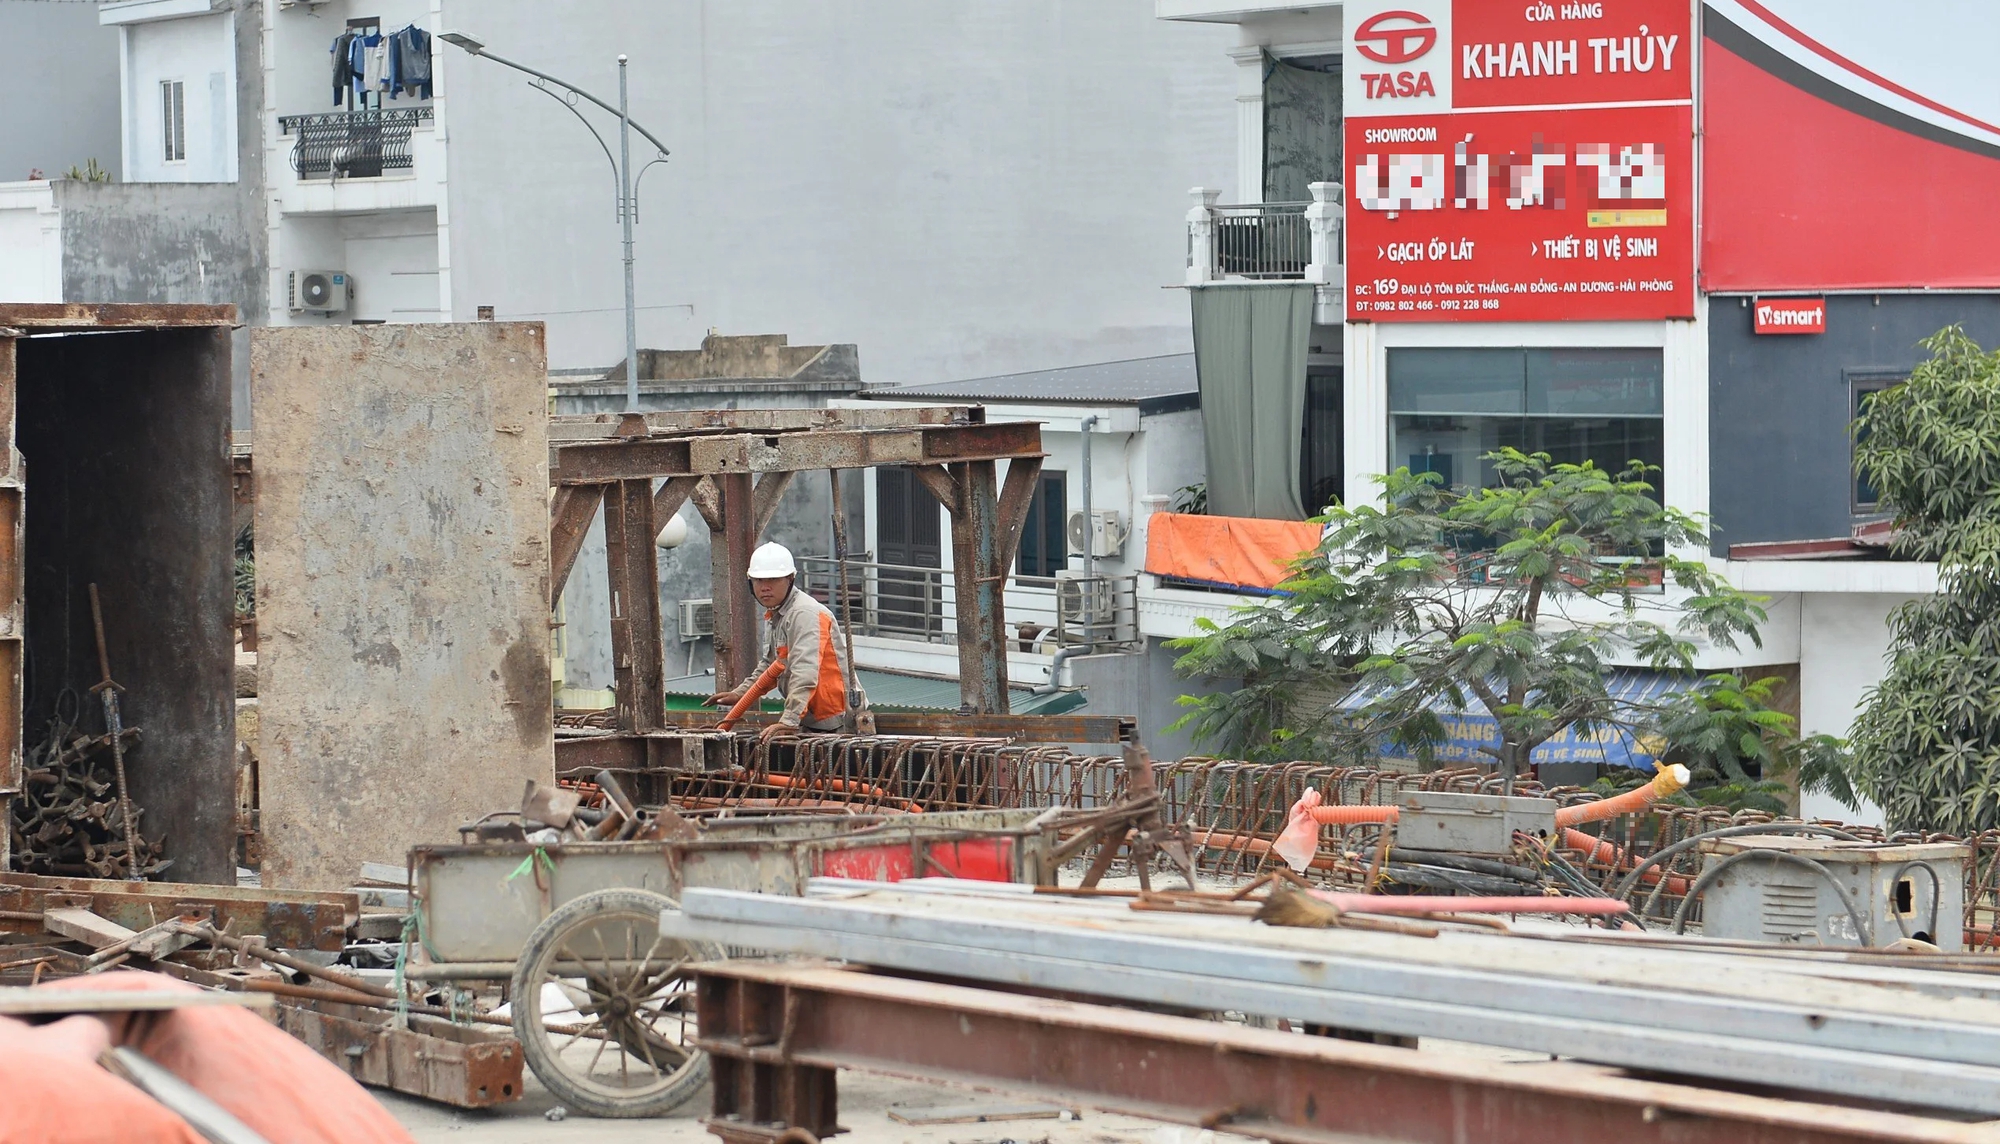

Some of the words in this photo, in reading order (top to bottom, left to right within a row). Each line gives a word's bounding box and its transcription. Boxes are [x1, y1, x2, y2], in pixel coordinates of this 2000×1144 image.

[1525, 0, 1555, 21] CỬA
[1561, 0, 1603, 20] HÀNG
[1462, 39, 1578, 79] KHANH
[1587, 24, 1679, 74] THỦY
[1360, 71, 1436, 99] TASA
[1365, 127, 1437, 143] SHOWROOM
[1387, 242, 1424, 265] GẠCH
[1428, 236, 1447, 261] ỐP
[1450, 237, 1475, 260] LÁT
[1543, 233, 1580, 259] THIẾT
[1585, 238, 1598, 261] BỊ
[1603, 234, 1621, 261] VỆ
[1626, 237, 1658, 257] SINH
[1373, 278, 1399, 295] 169
[1401, 284, 1417, 297] ĐẠI
[1434, 283, 1453, 294] TÔN
[1639, 279, 1674, 292] PHÒNG
[1374, 301, 1396, 311] 0982
[1398, 300, 1414, 311] 802
[1416, 300, 1434, 310] 466
[1440, 299, 1460, 310] 0912
[1463, 299, 1479, 310] 228
[1482, 299, 1500, 309] 868
